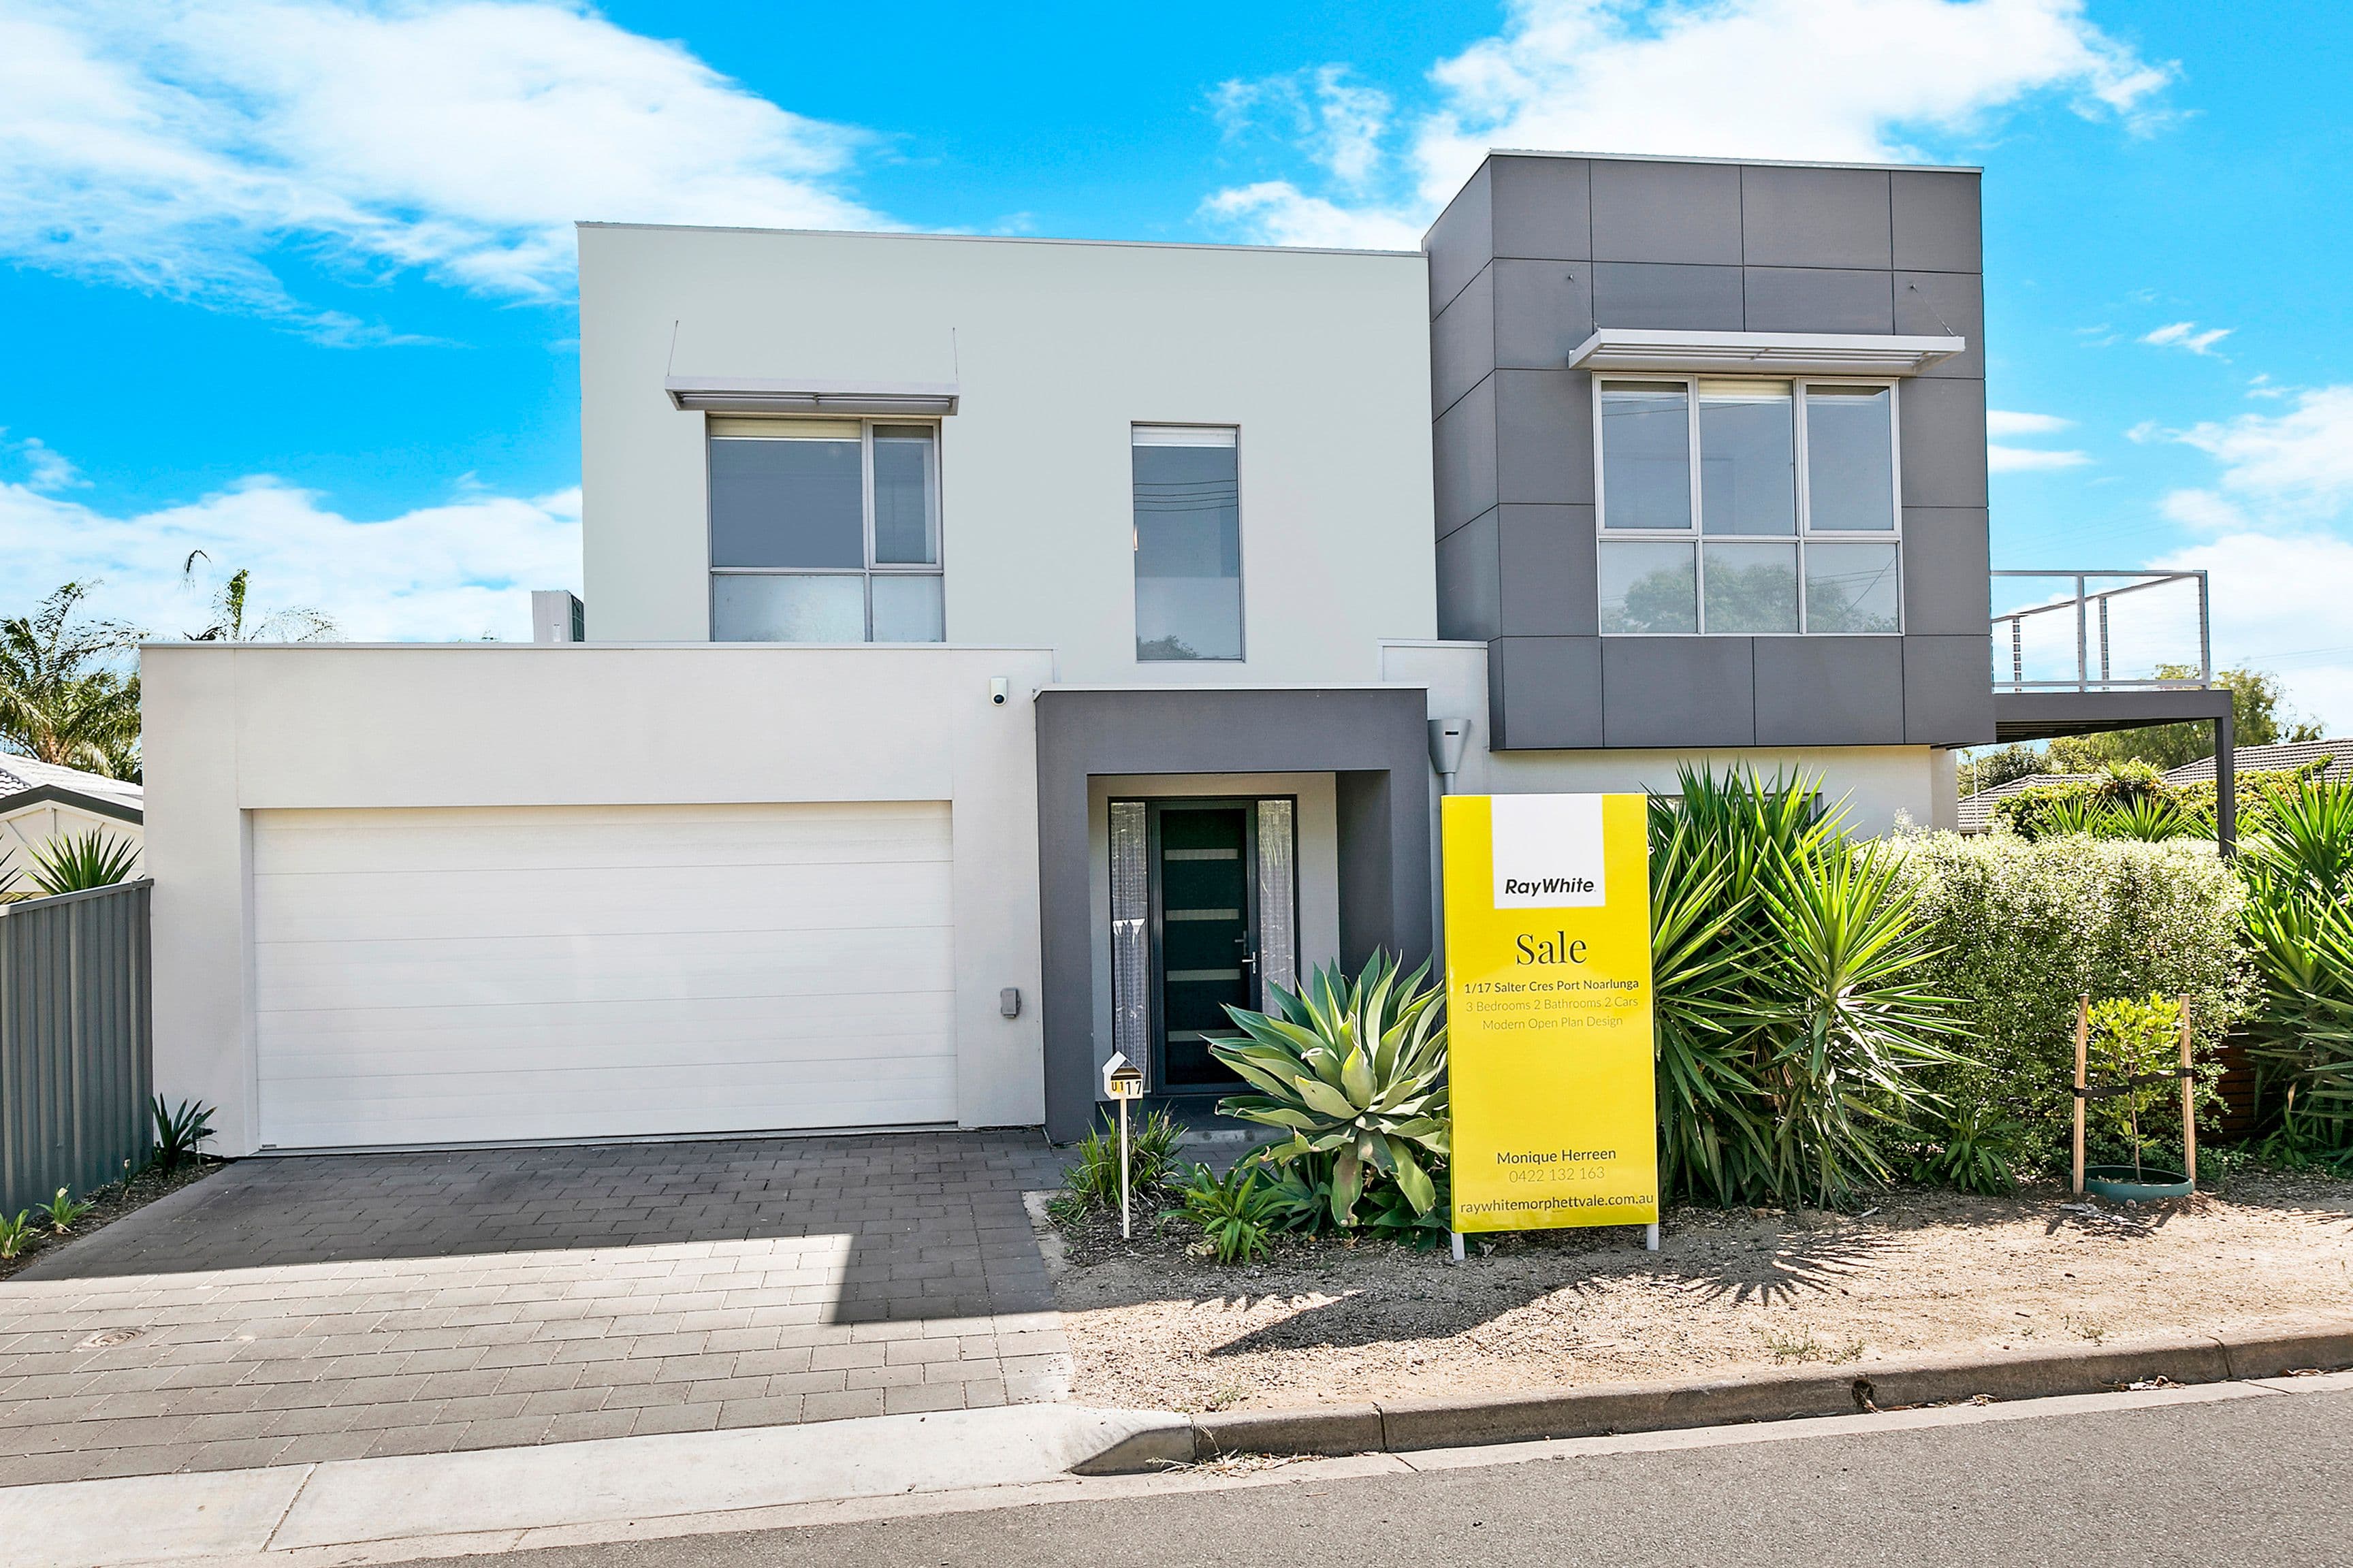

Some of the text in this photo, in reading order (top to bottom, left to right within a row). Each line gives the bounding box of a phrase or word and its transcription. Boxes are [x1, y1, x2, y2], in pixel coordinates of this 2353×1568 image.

[1516, 931, 1587, 965] Sale
[1464, 979, 1639, 994] 1/17 Salter Cres Port Noarlunga
[1466, 996, 1638, 1012] 3 Bedrooms 2 Bathrooms 2 Cars
[1483, 1015, 1623, 1030] Modern Open Plan Design
[1111, 1081, 1142, 1095] U1 17
[1497, 1149, 1616, 1165] Monique Herreen
[1509, 1166, 1605, 1183] 0422 132 163
[1460, 1194, 1654, 1215] raywhitemorphettvale.com.au
